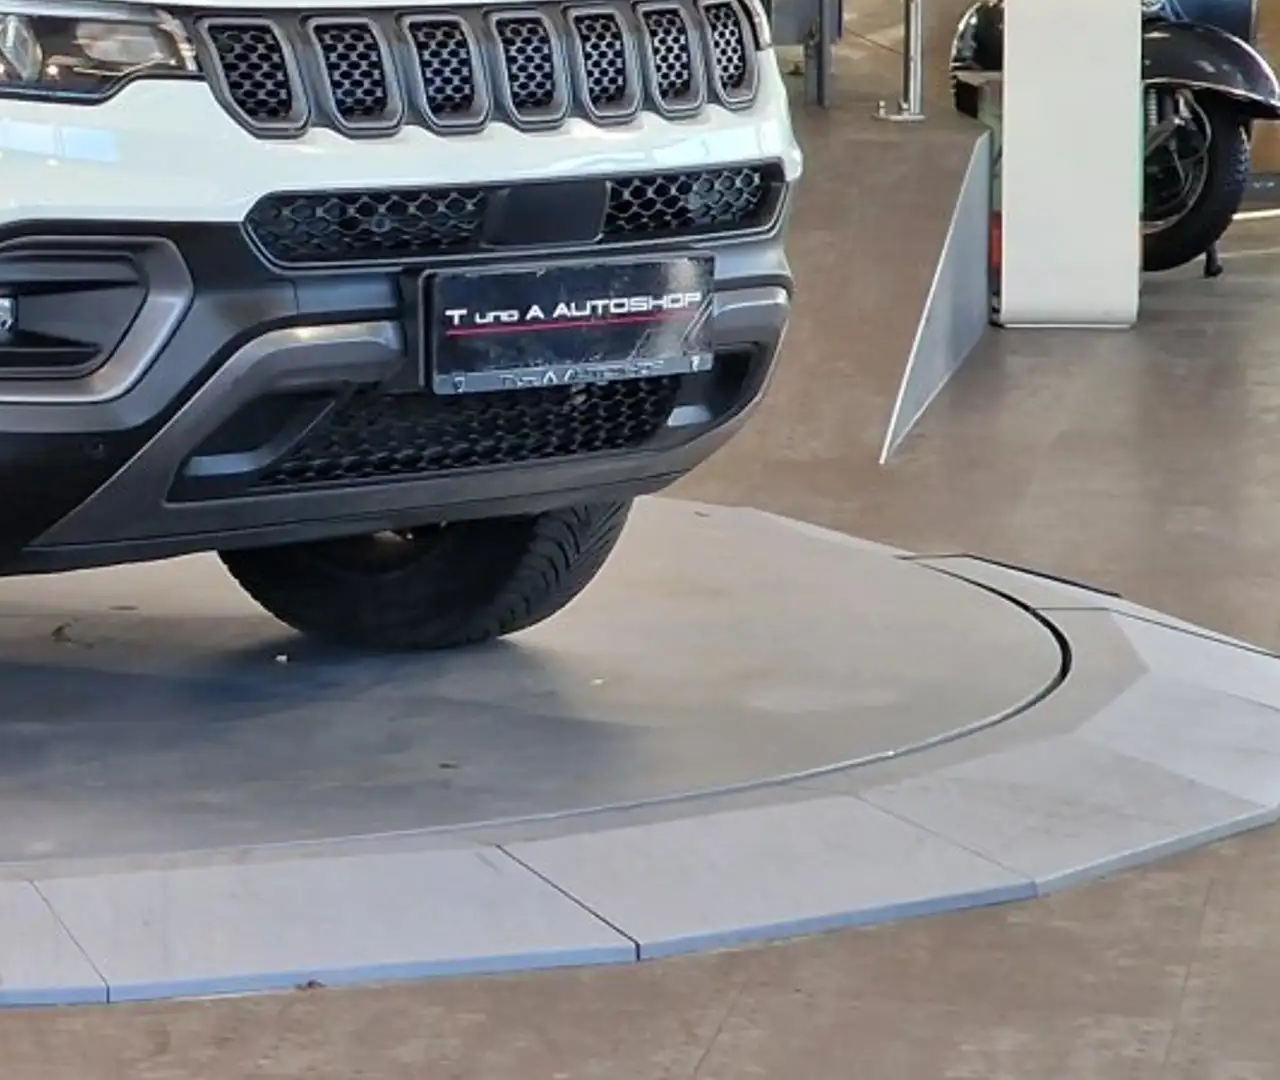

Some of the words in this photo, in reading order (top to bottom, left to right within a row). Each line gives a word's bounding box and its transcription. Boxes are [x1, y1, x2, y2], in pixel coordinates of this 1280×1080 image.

[444, 308, 468, 326] T
[524, 303, 545, 320] A
[552, 291, 704, 319] AUTOSHOP
